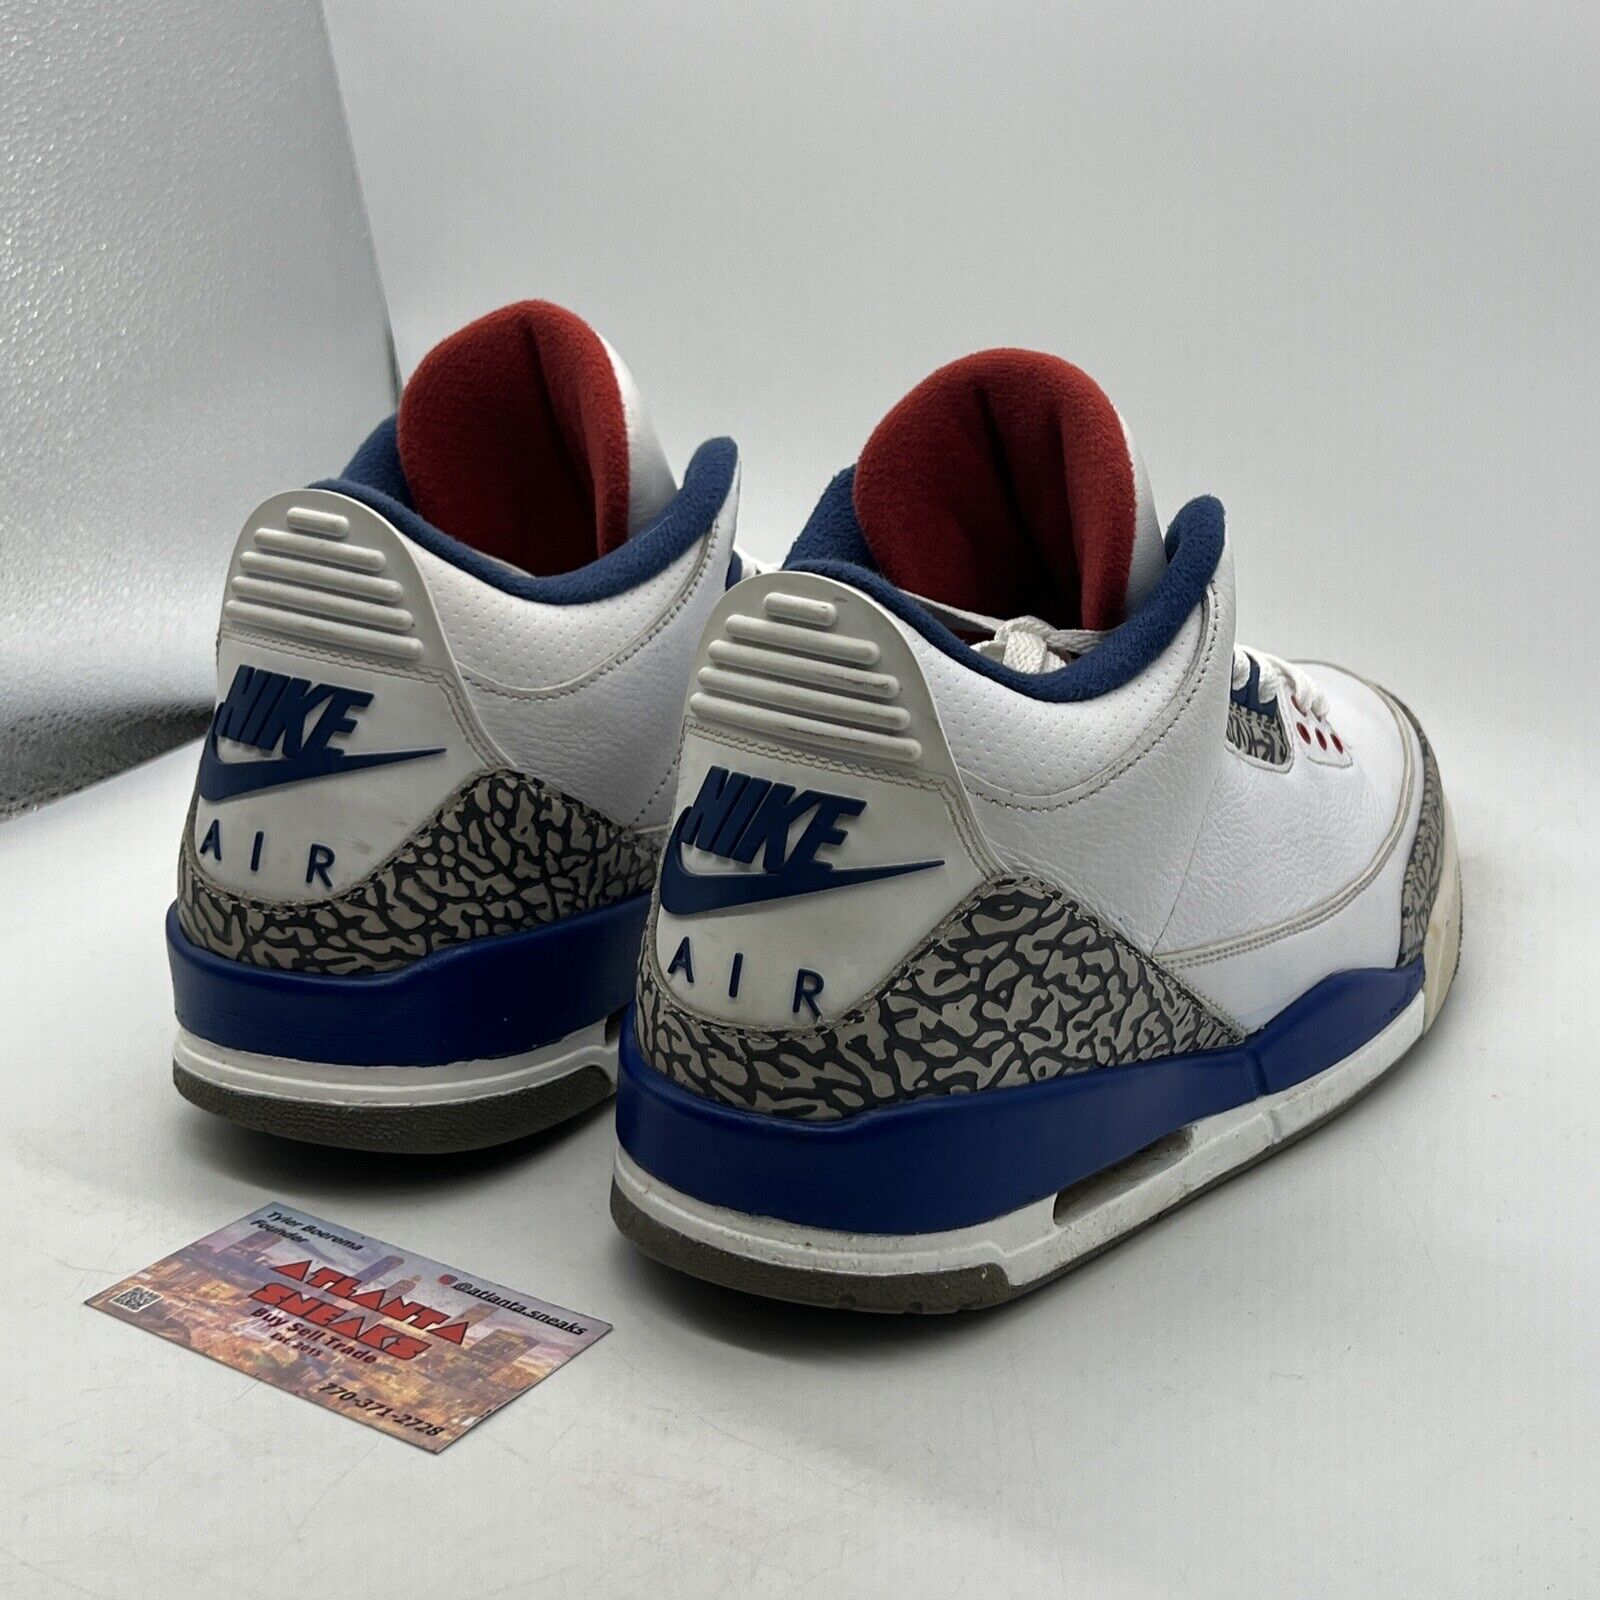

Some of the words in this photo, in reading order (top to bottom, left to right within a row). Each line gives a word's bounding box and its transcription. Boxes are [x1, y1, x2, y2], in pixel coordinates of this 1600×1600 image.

[215, 664, 375, 758] NIKE
[199, 819, 336, 889] AIR
[680, 765, 868, 874] NIKE
[667, 936, 825, 1018] AIR
[250, 1220, 310, 1242] Founder
[267, 1211, 303, 1227] Tyler
[301, 1225, 364, 1251] Boerema
[248, 1282, 433, 1360] SNEAKS
[251, 1307, 289, 1328] Buy
[287, 1322, 324, 1341] Sell
[323, 1335, 378, 1364] Trade
[270, 1259, 469, 1345] ATLANTA
[451, 1282, 588, 1336] @atlanta.sneaks
[319, 1382, 445, 1436] 770-371-2728
